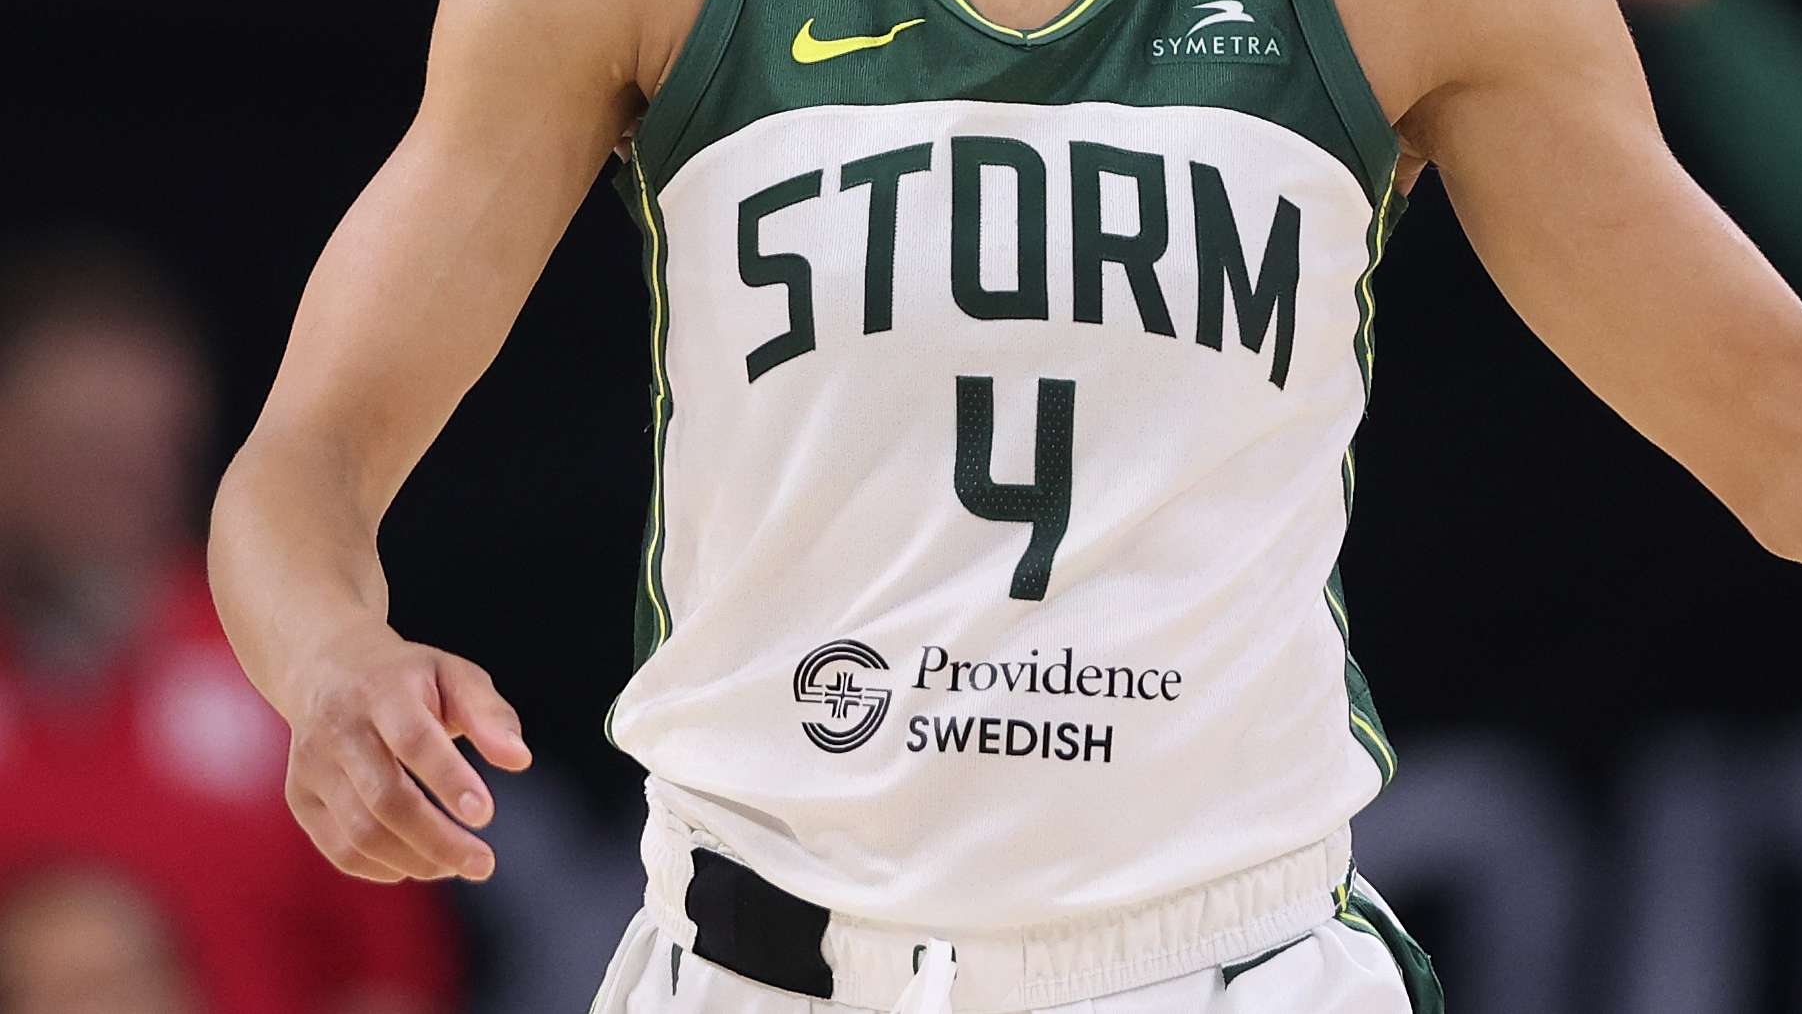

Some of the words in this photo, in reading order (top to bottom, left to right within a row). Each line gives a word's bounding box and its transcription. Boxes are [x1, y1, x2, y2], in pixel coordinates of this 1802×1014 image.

[1152, 36, 1281, 57] SYMETRA
[737, 136, 1301, 391] STORM
[954, 375, 1076, 601] 4
[911, 645, 1182, 702] Providence
[906, 715, 1113, 763] SWEDISH
